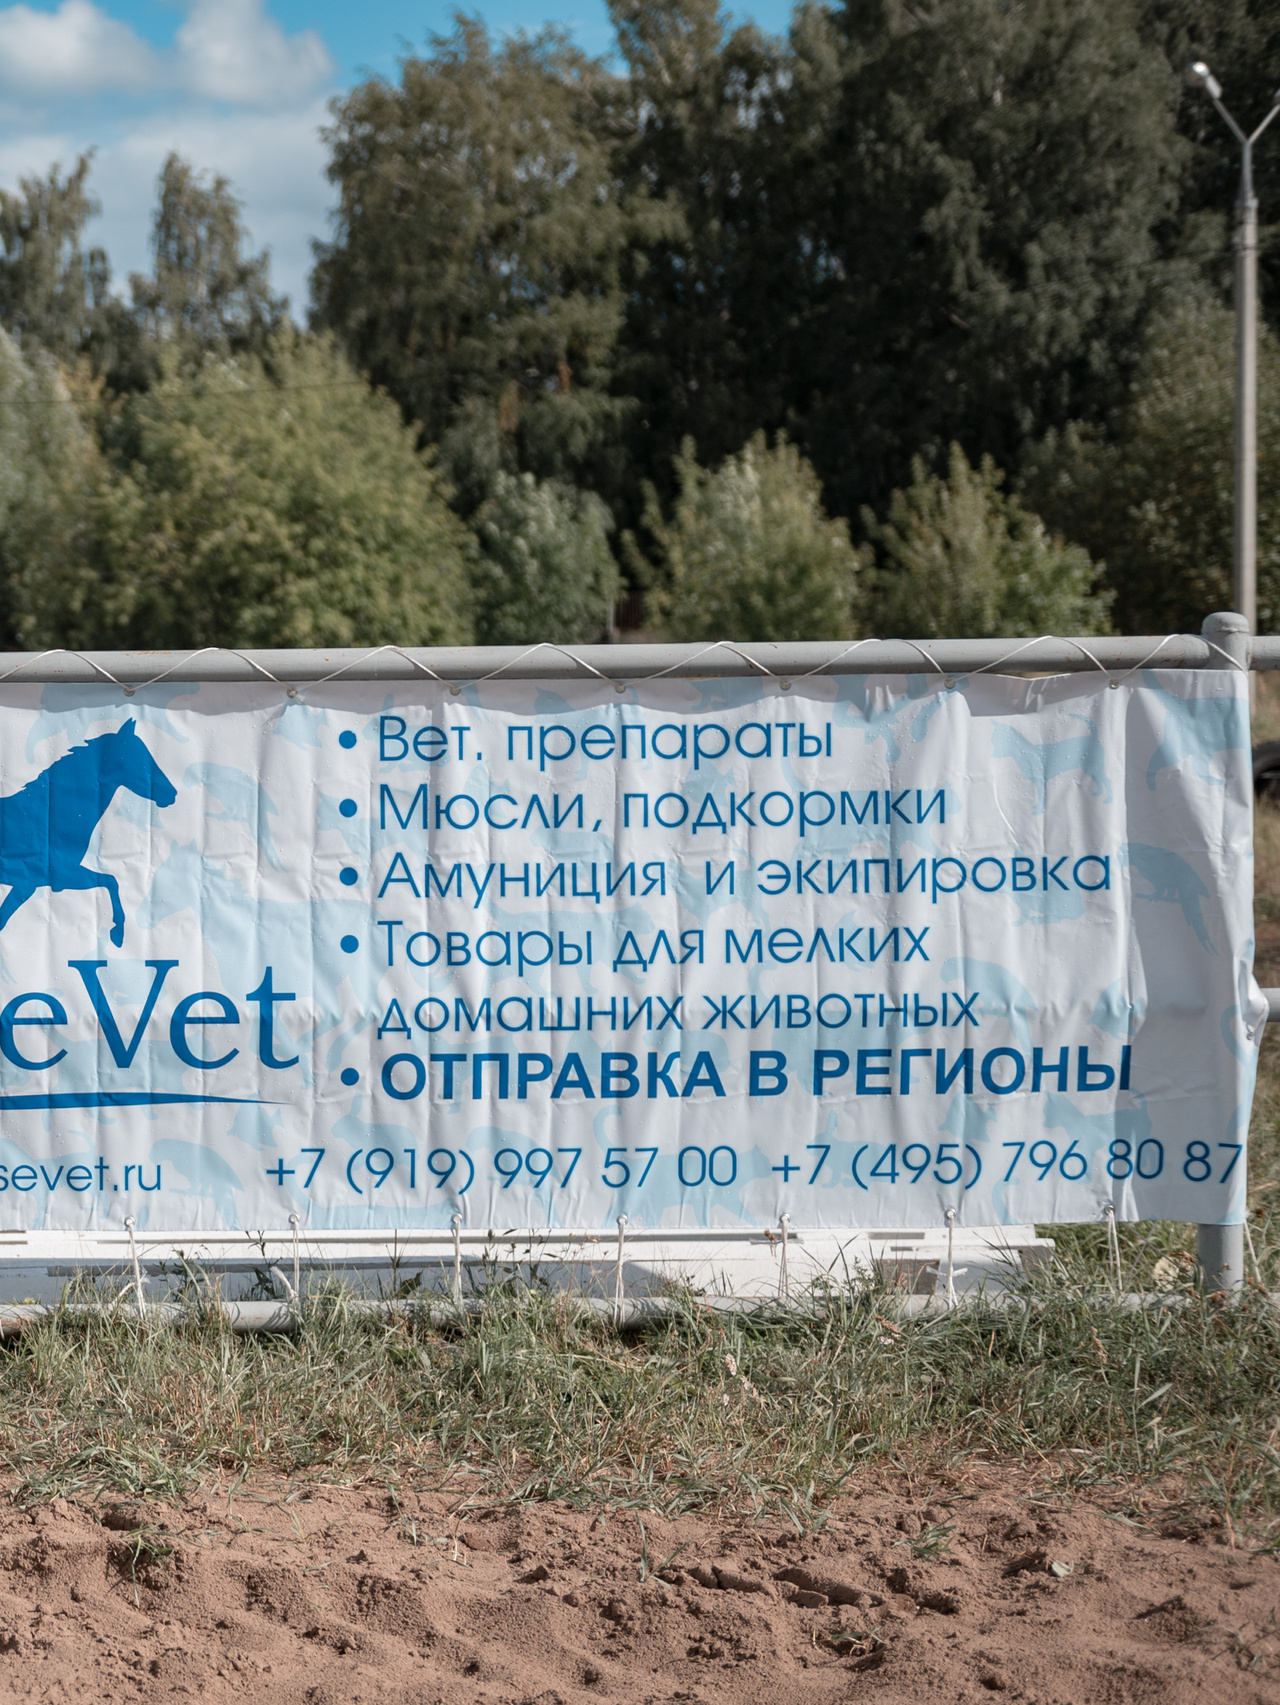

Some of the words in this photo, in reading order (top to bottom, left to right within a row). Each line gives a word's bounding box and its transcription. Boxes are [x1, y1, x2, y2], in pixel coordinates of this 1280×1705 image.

[379, 715, 483, 762] Вет.
[508, 722, 832, 771] препараты
[379, 783, 603, 833] Мюсли,
[624, 789, 946, 838] подкормки
[377, 851, 666, 910] Амуниция
[705, 861, 735, 896] и
[757, 856, 1111, 905] экипировка
[377, 920, 593, 978] Товары
[613, 929, 704, 973] для
[725, 926, 930, 964] мелких
[377, 995, 685, 1040] домашних
[702, 991, 980, 1030] животных
[381, 1051, 727, 1101] ОТПРАВКА
[749, 1050, 788, 1097] В
[812, 1044, 1132, 1096] РЕГИОНЫ
[266, 1147, 325, 1189] +7
[346, 1146, 475, 1196] (919)
[493, 1147, 583, 1189] 997
[601, 1147, 659, 1189] 57
[677, 1144, 738, 1188] 00
[771, 1144, 832, 1185] +7
[851, 1142, 983, 1191] (495)
[1003, 1139, 1089, 1183] 796
[1105, 1138, 1165, 1180] 80
[1183, 1140, 1244, 1183] 87
